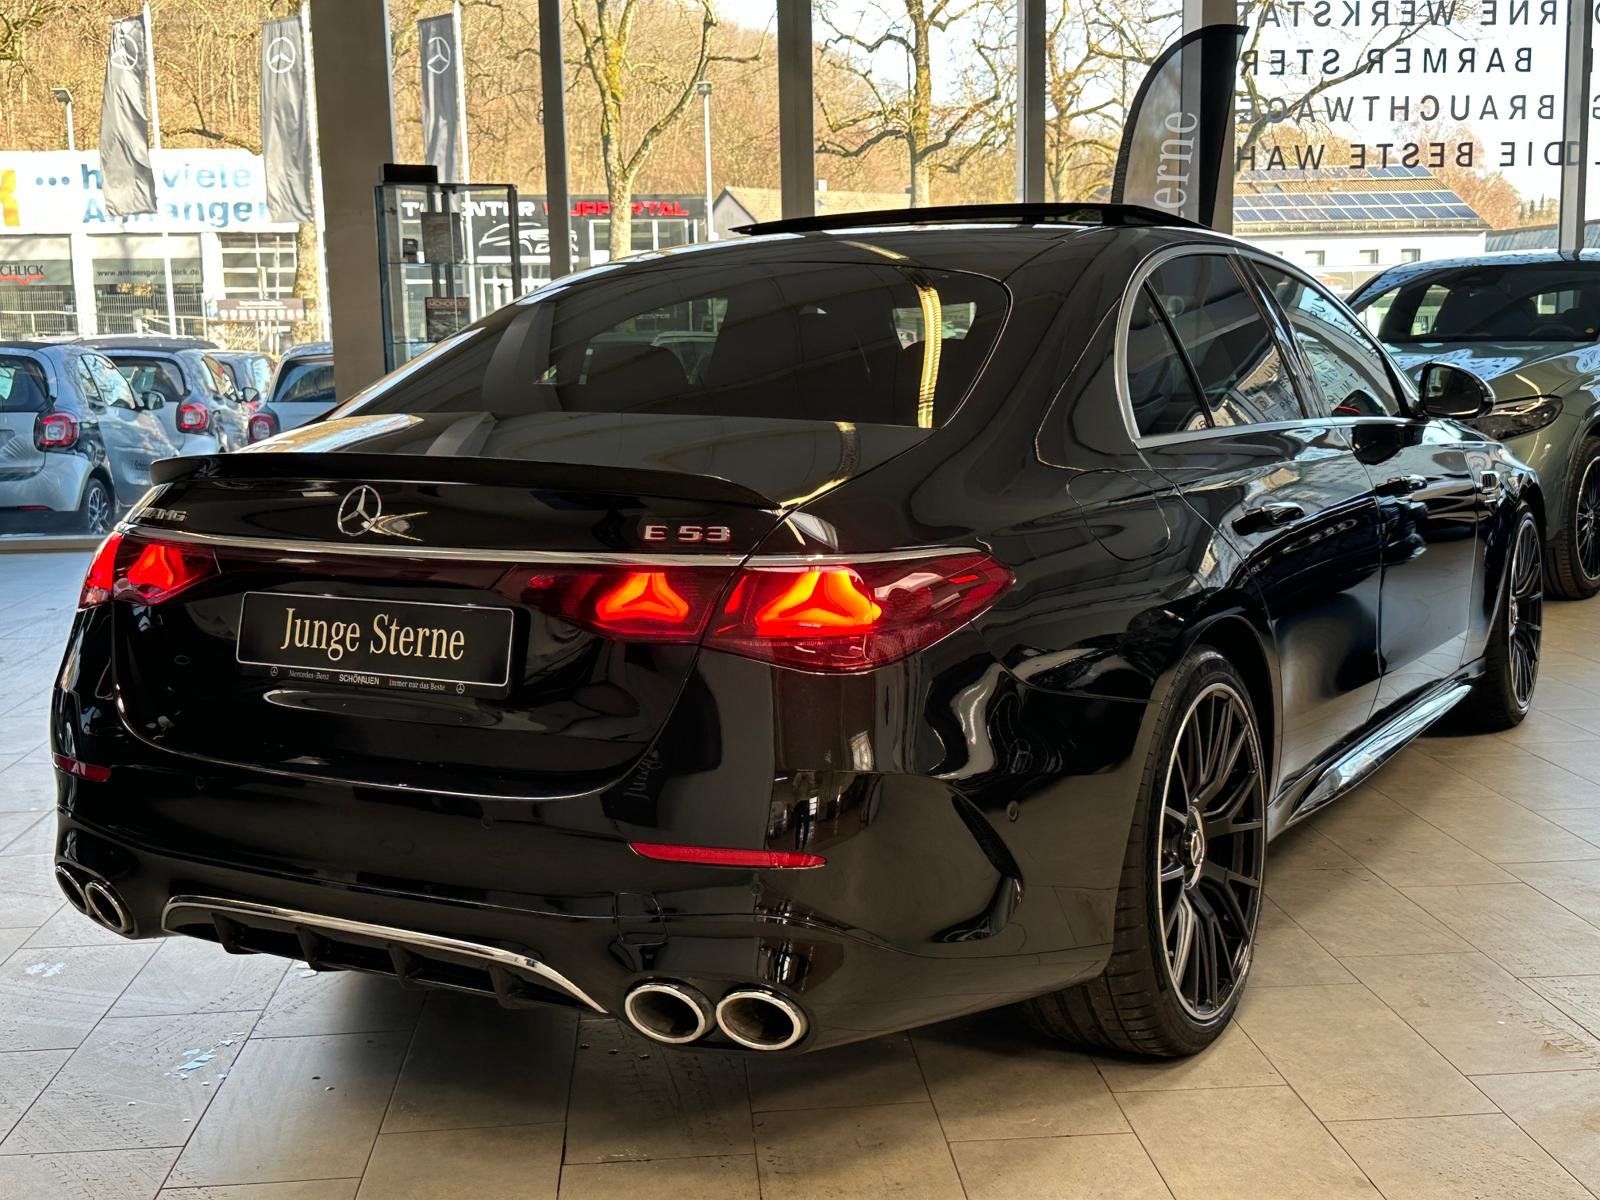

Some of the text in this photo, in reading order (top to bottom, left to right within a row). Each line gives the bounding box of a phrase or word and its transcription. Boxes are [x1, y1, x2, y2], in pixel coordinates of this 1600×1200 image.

[1153, 111, 1198, 218] erne
[162, 163, 251, 188] viele
[0, 264, 45, 276] CHLICK
[145, 507, 187, 521] AMG
[643, 525, 731, 542] E 53
[280, 607, 465, 661] Junge Sterne
